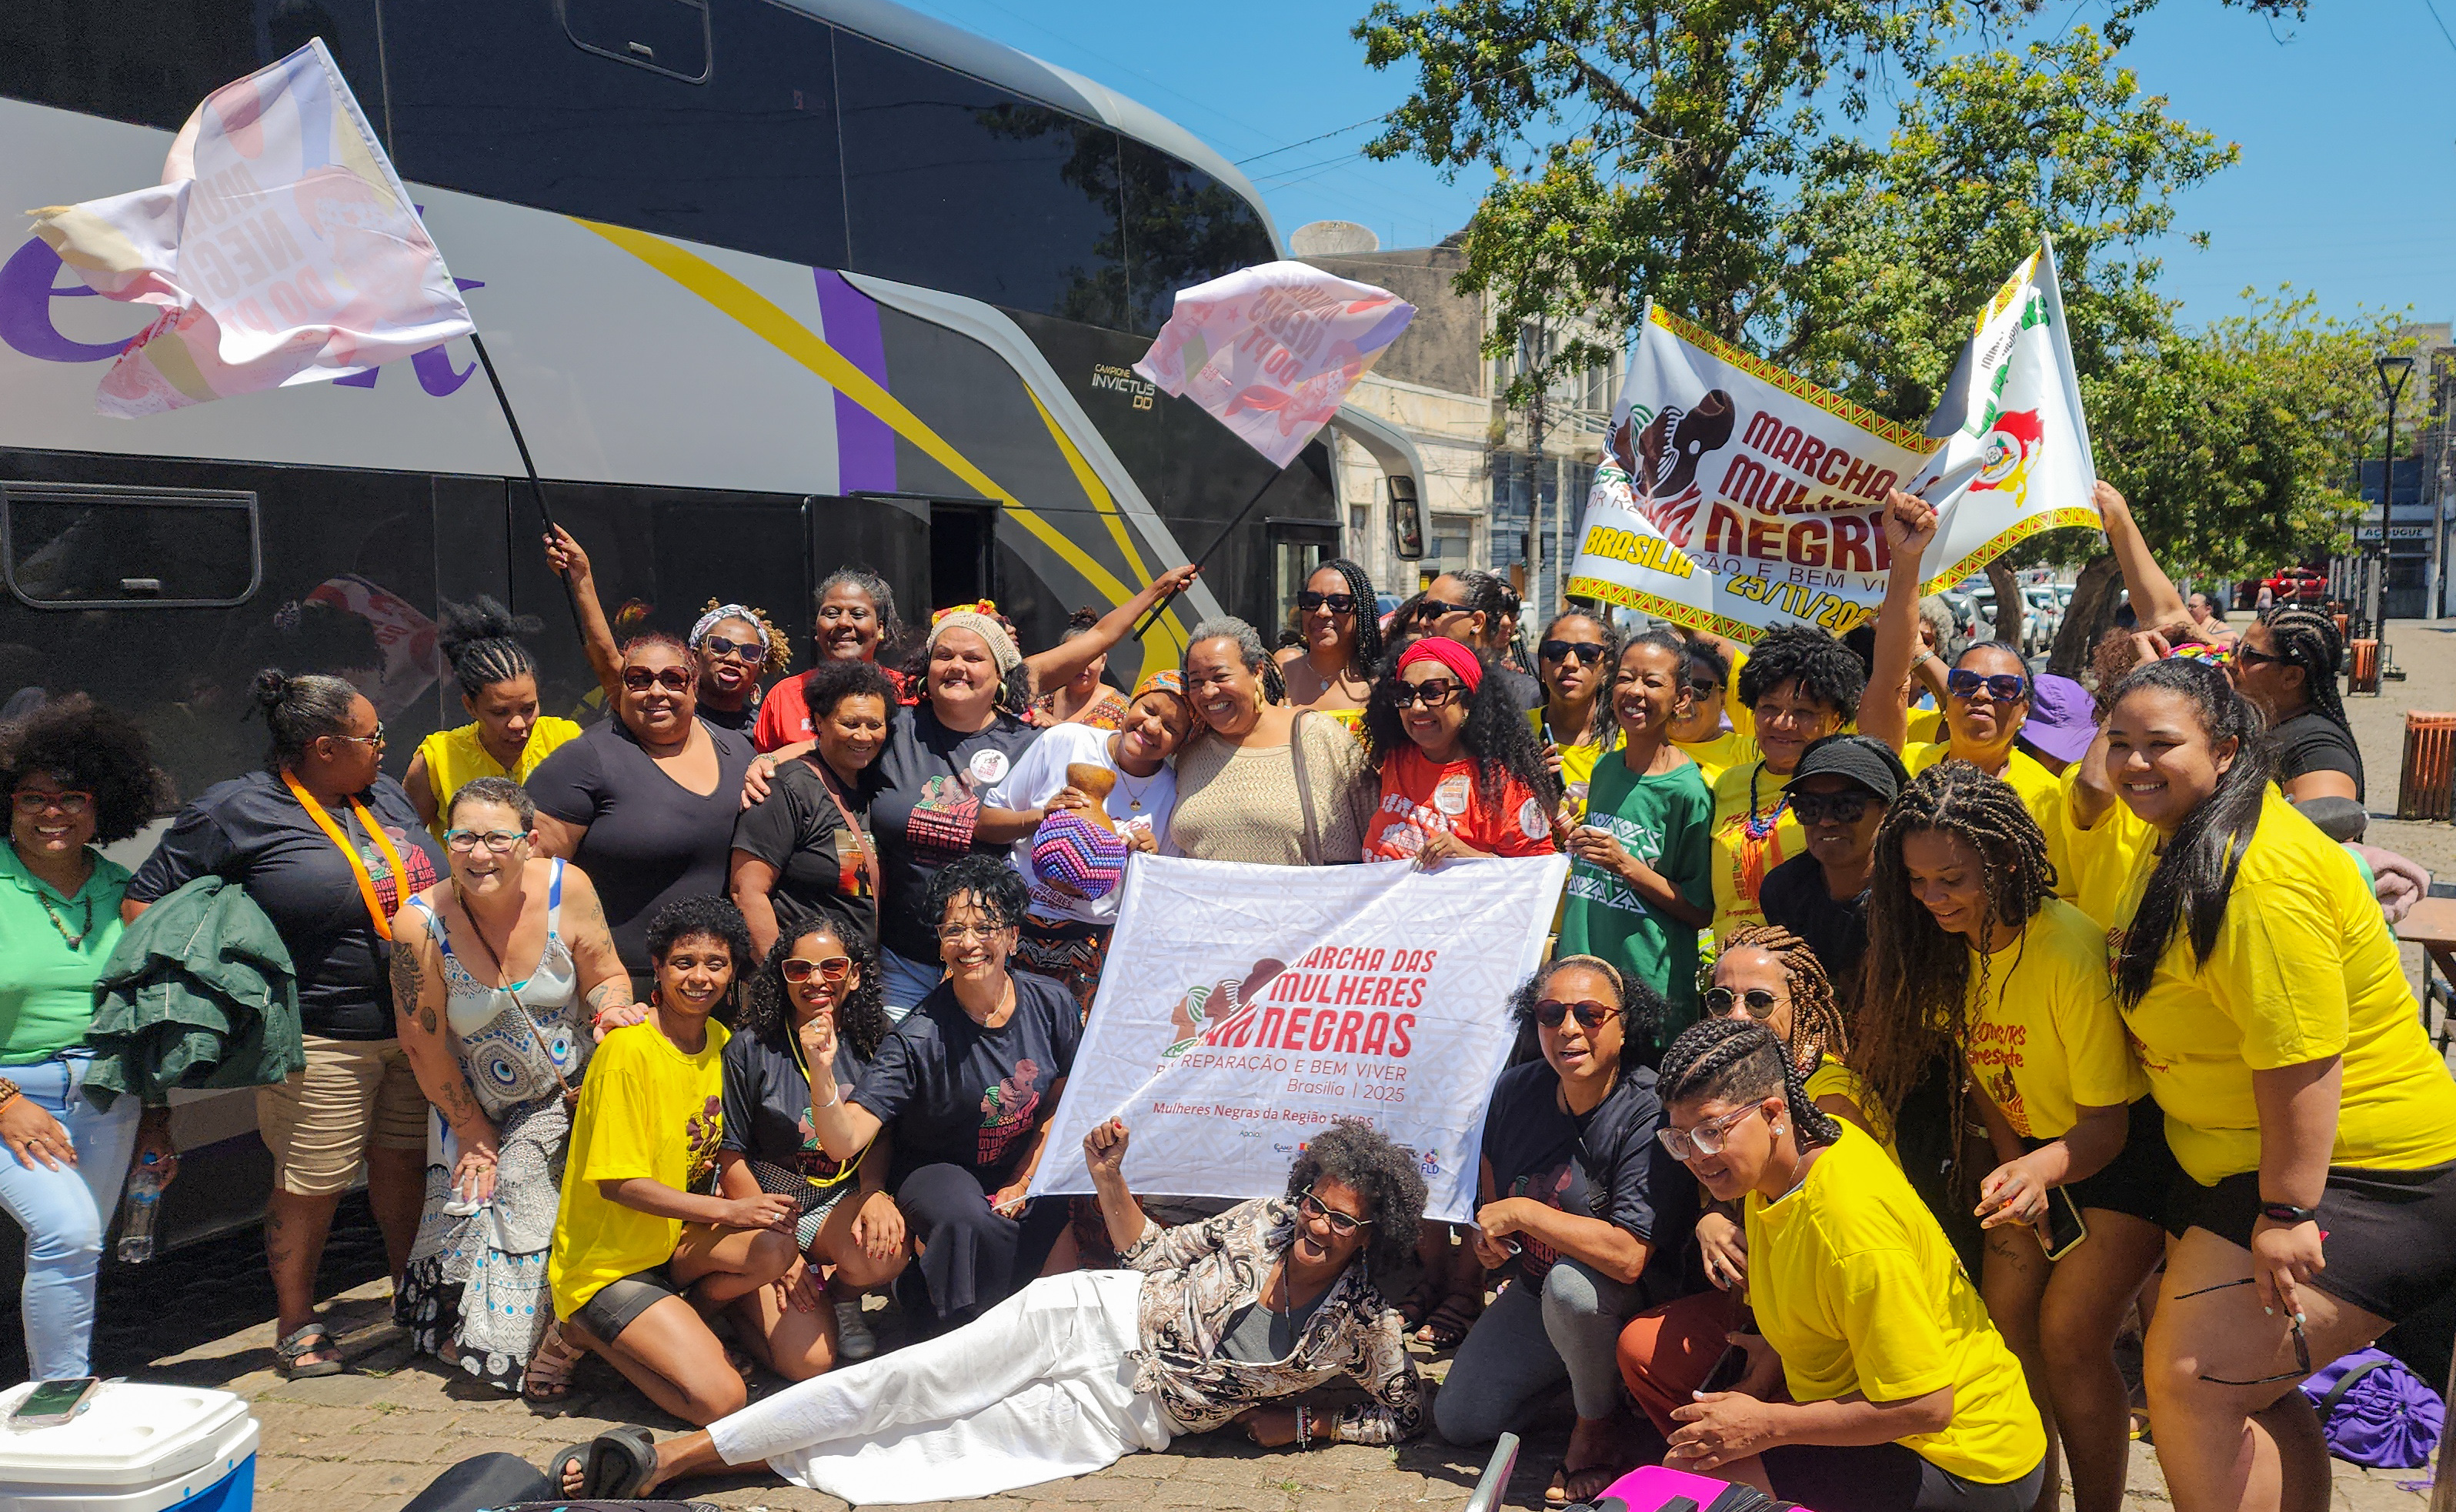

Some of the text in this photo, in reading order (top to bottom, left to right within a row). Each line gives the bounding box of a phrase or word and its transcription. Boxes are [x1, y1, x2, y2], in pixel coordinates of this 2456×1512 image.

[1092, 372, 1156, 396] INVICTUS
[1133, 394, 1153, 410] DD
[1742, 411, 1898, 502] MARCHA
[1704, 501, 1892, 572] NEGR
[1581, 525, 1694, 579] BRASILIA
[1789, 566, 1845, 589] BEM
[1390, 949, 1437, 973] DAS
[1268, 973, 1427, 1008] MULHERES
[1253, 1006, 1417, 1058] NEGRAS
[1181, 1053, 1287, 1073] REPARAÇÃO
[1294, 1060, 1305, 1073] E
[1310, 1060, 1347, 1076] BEM
[1356, 1063, 1407, 1081] VIVER
[1286, 1078, 1345, 1096] Brasília
[1363, 1084, 1405, 1102] 2025
[1153, 1103, 1211, 1115] Mulheres
[1214, 1104, 1260, 1120] Negras
[1263, 1107, 1278, 1120] da
[1282, 1109, 1326, 1126] Região
[1420, 1163, 1440, 1174] FLD
